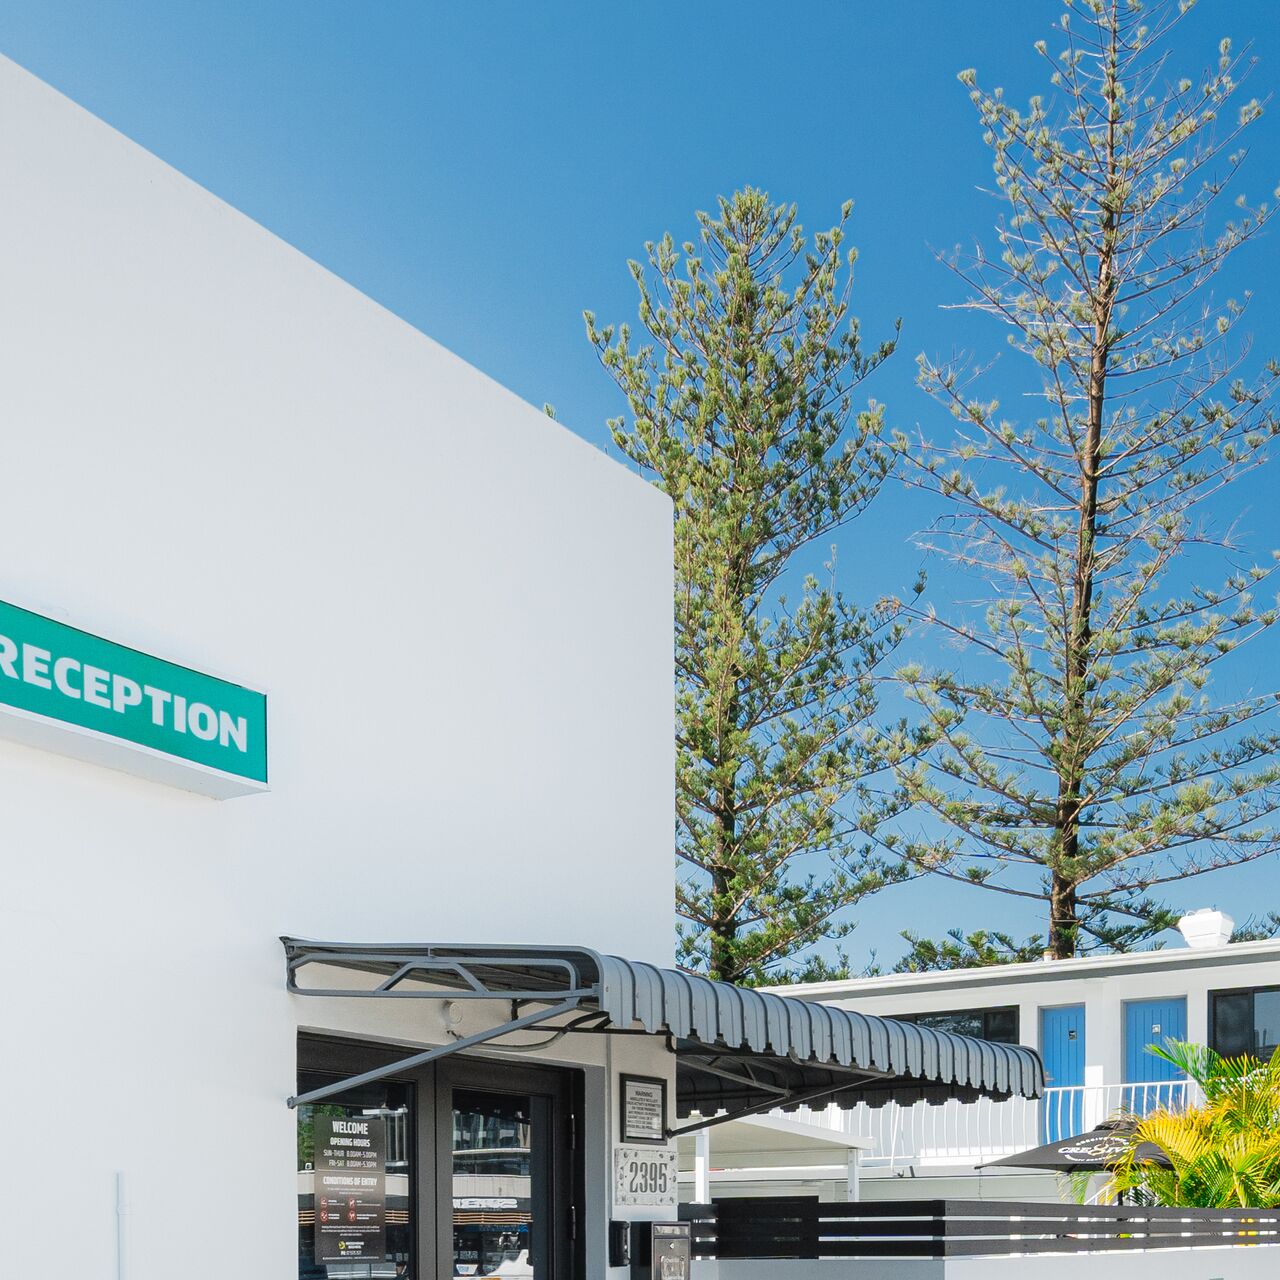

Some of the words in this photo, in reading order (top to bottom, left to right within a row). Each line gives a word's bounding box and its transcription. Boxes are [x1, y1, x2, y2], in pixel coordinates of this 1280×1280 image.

[332, 1121, 368, 1135] WELCOME
[330, 1137, 352, 1146] OPENING
[353, 1138, 371, 1147] HOURS
[323, 1176, 353, 1185] CONDITIONS
[354, 1177, 360, 1185] OF
[361, 1177, 378, 1186] ENTRY
[629, 1161, 668, 1193] 2395
